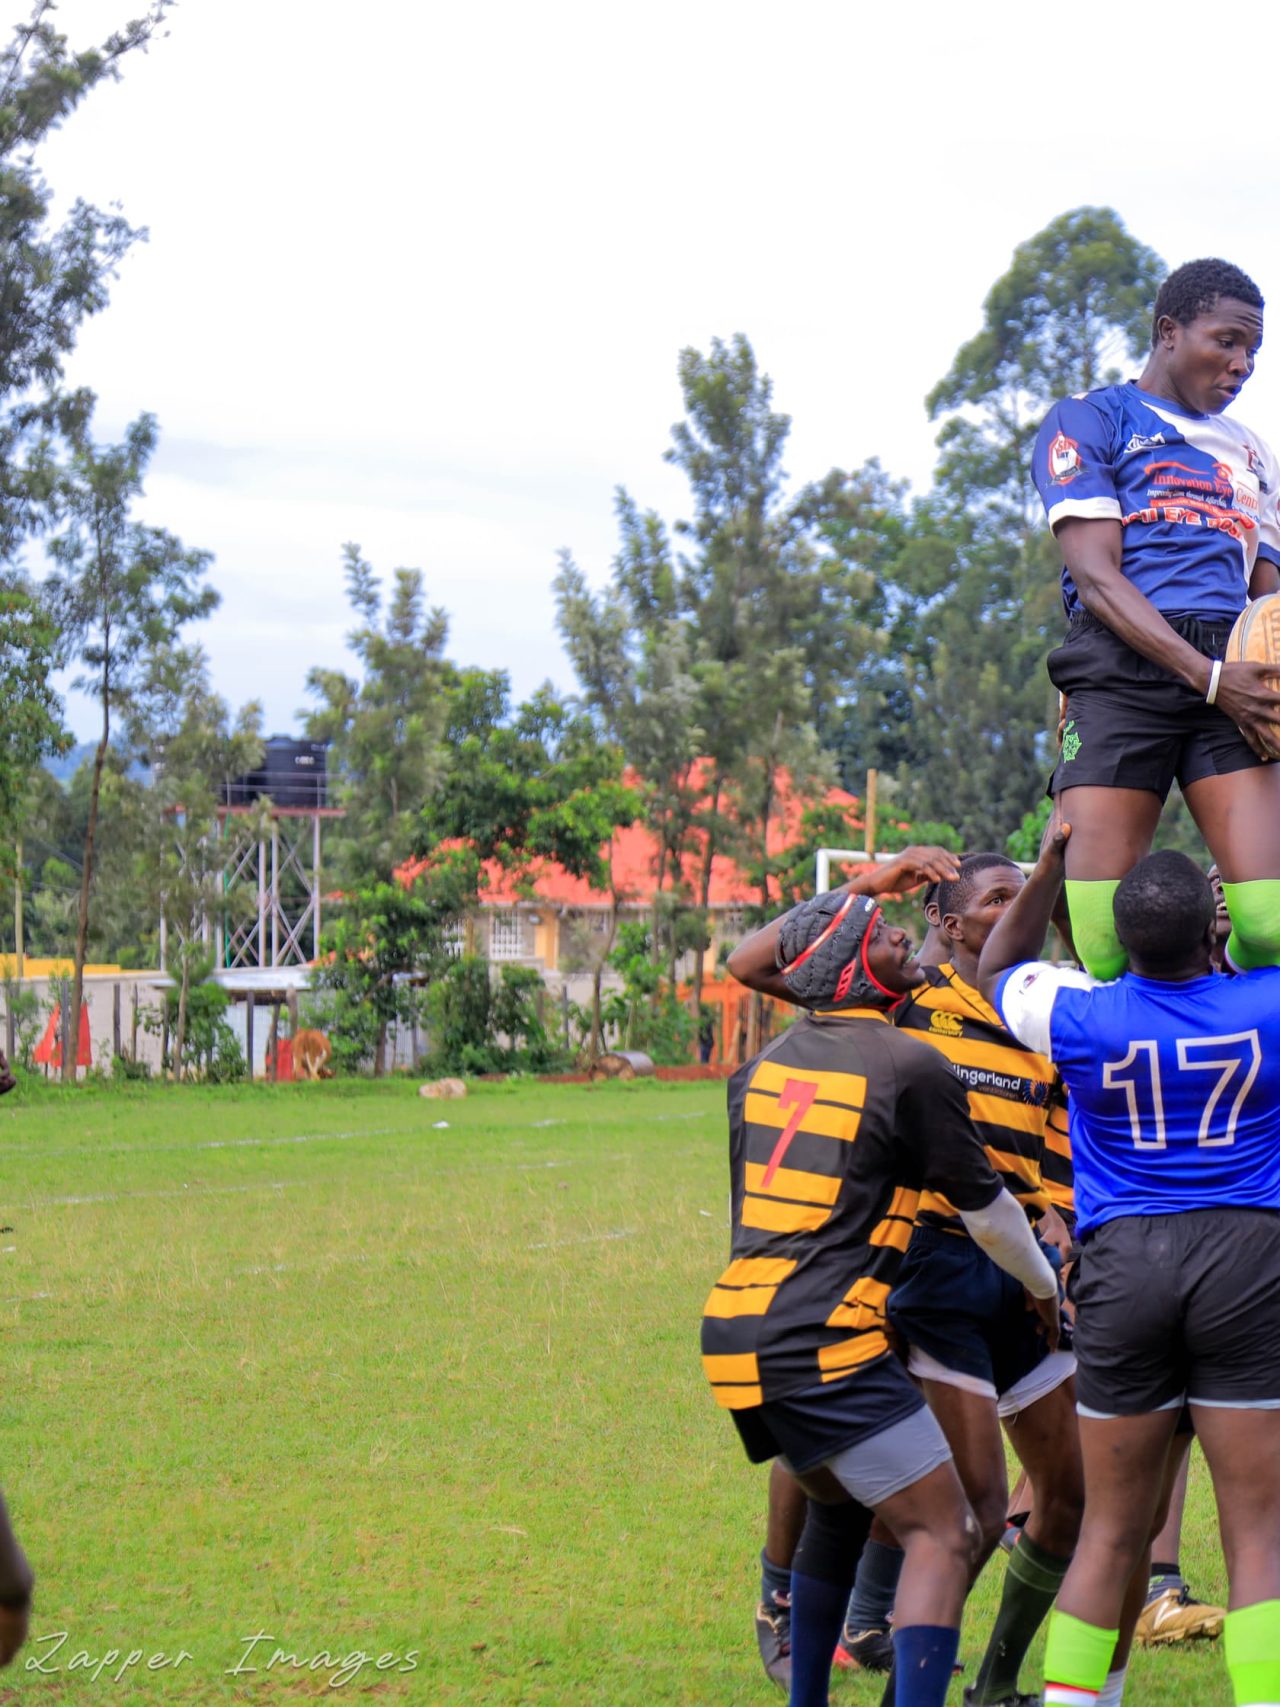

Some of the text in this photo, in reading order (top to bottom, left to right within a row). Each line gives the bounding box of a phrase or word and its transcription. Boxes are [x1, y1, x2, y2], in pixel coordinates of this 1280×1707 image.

[1163, 506, 1202, 526] EYE
[953, 1064, 1021, 1090] lingerland
[1102, 1028, 1262, 1150] 17
[760, 1078, 819, 1189] 7
